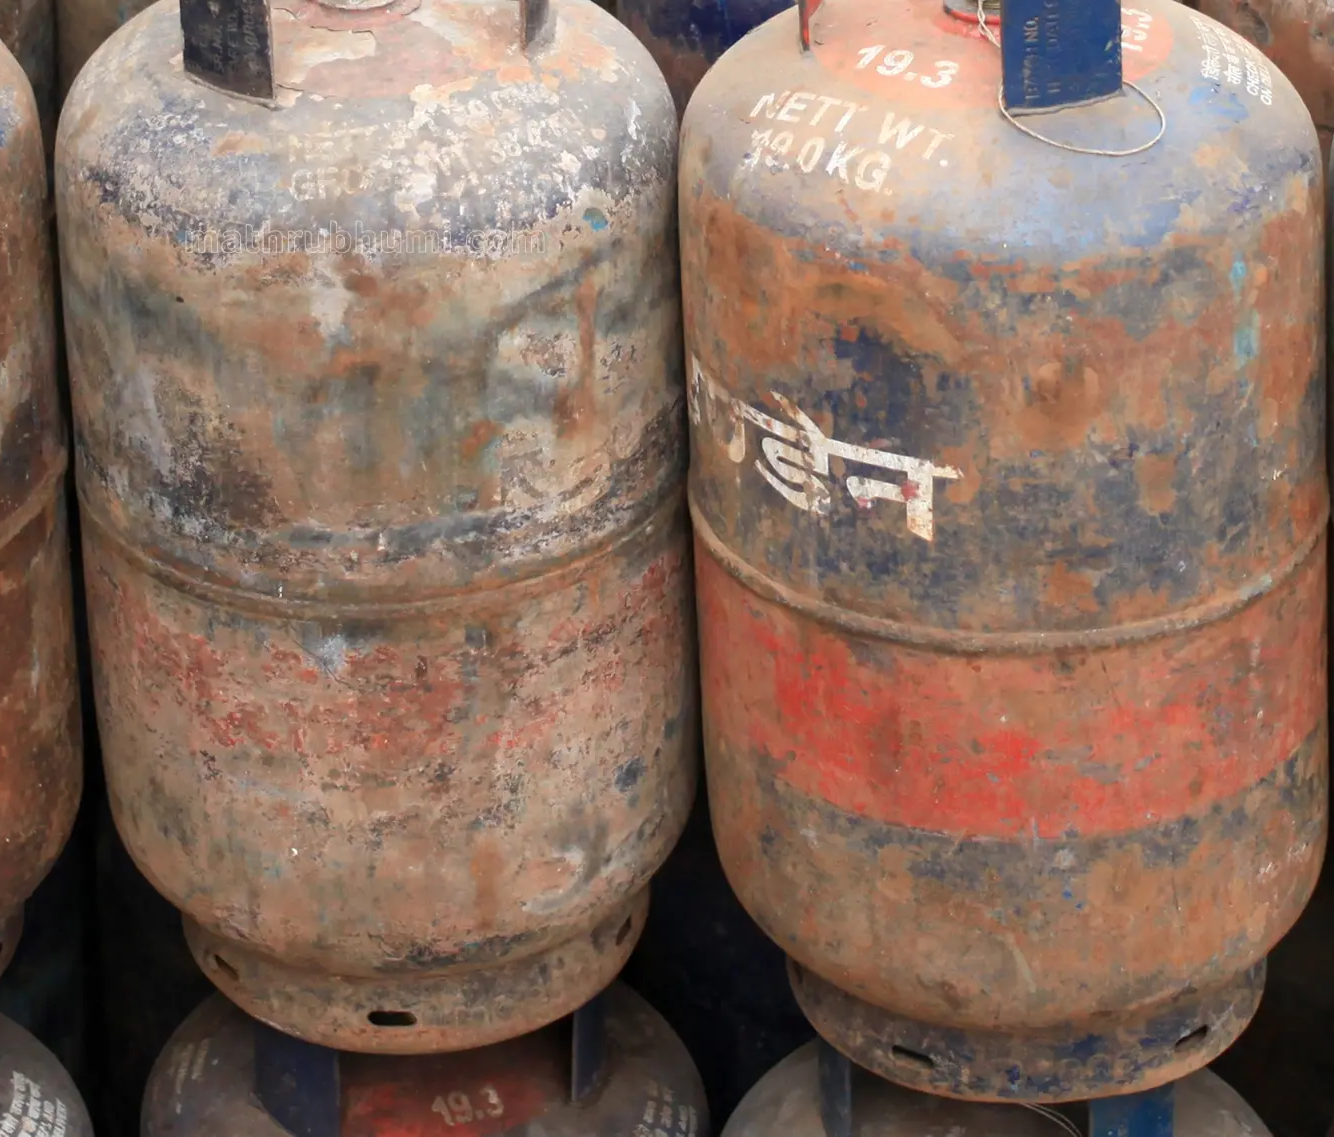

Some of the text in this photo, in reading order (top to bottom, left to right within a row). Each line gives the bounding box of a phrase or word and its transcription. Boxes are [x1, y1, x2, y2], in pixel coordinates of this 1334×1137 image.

[853, 44, 961, 89] 19.3
[749, 90, 956, 168] NETT WT.
[430, 1083, 505, 1127] 19.3
